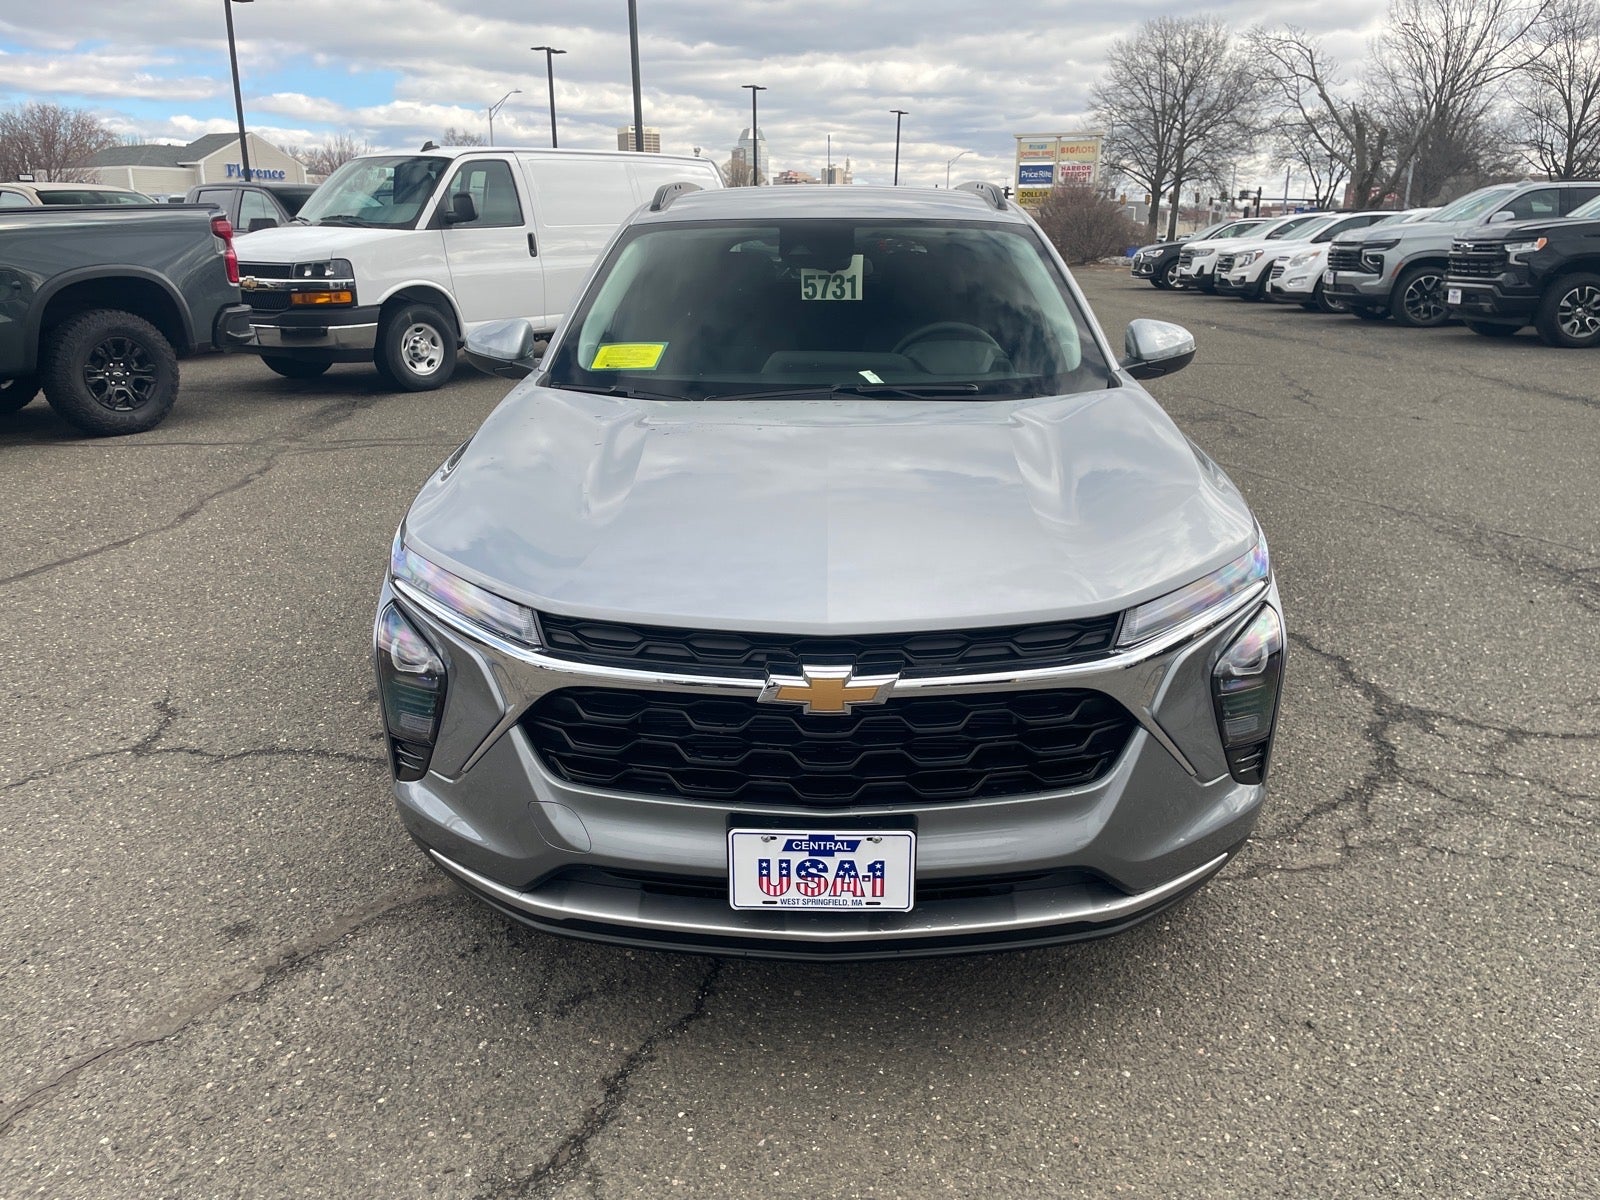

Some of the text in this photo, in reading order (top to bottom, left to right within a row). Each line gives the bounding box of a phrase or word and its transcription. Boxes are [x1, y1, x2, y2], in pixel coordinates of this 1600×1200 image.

[803, 274, 857, 299] 5731
[792, 841, 851, 851] CENTRAL
[758, 858, 885, 897] USA-1
[801, 898, 850, 907] SPRINGFIELD,
